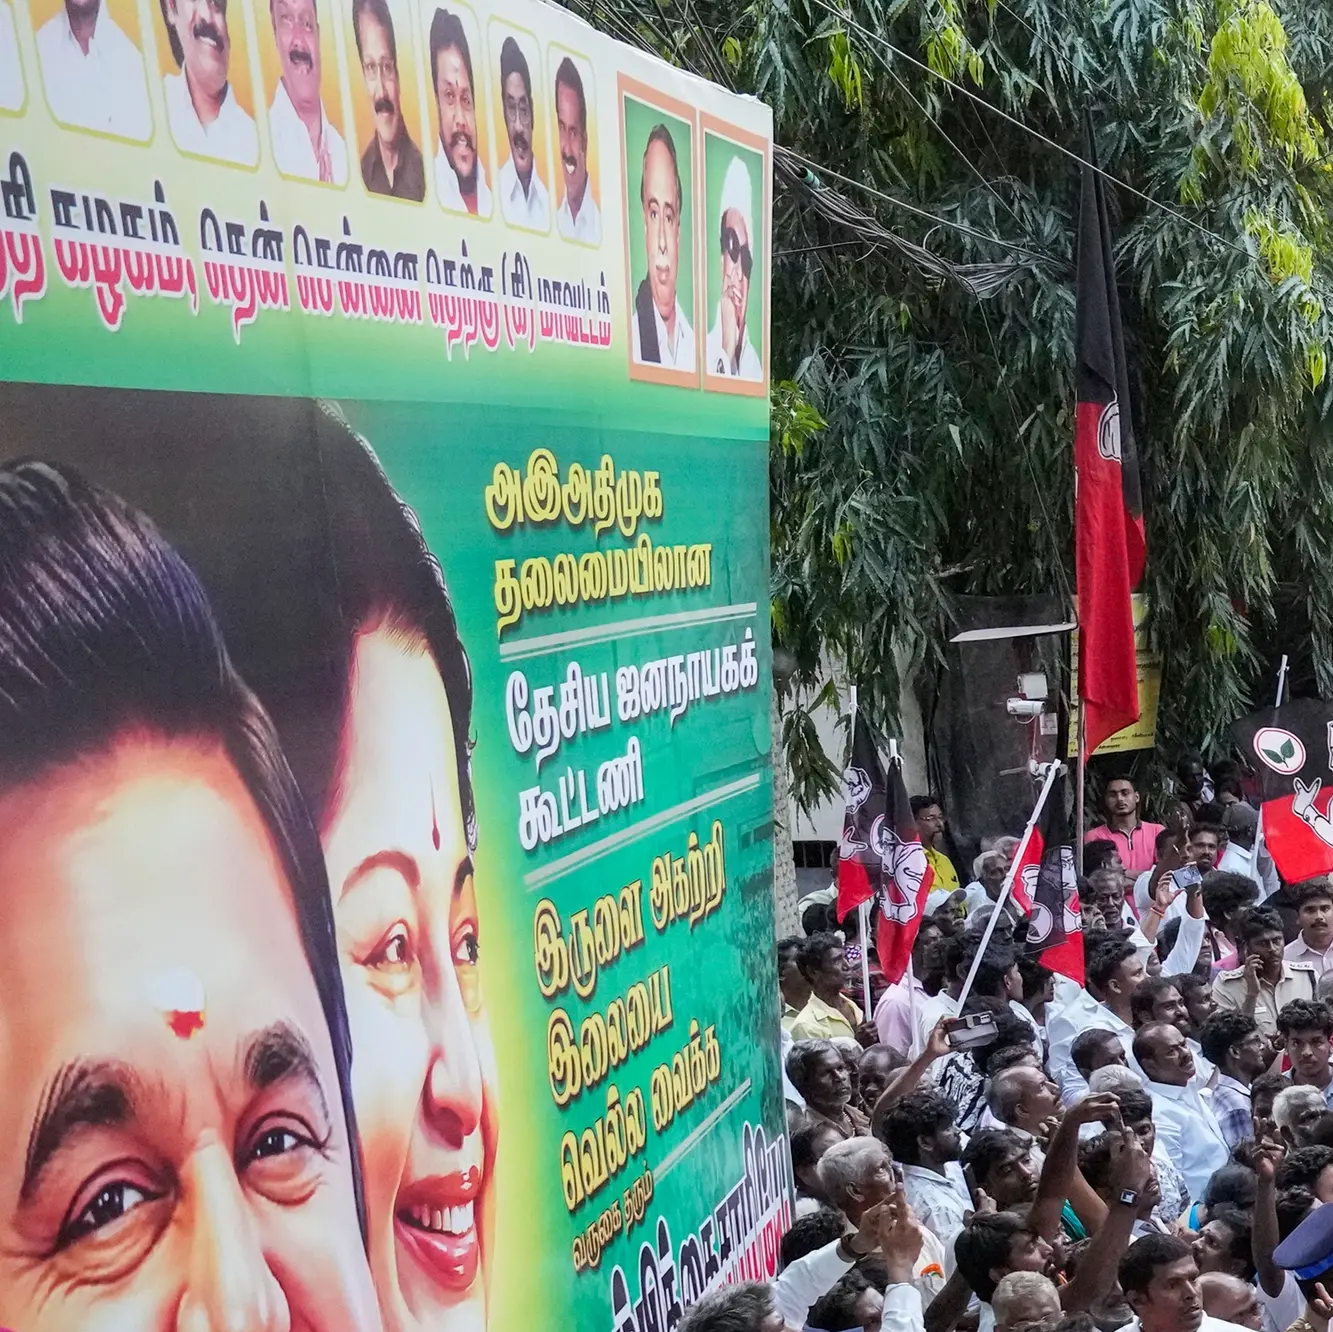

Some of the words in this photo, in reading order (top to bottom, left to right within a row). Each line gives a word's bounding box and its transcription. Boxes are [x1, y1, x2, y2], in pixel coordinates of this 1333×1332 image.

[50, 179, 198, 328] கழகம்,
[201, 199, 290, 340] தென்
[293, 215, 423, 322] சென்னை
[425, 238, 500, 359] தெற்கு
[537, 270, 613, 348] மாவட்டம்
[484, 447, 664, 537] அஇஅதிமுக
[493, 533, 712, 632] தலைமையிலான
[505, 661, 612, 773] தேசிய
[616, 627, 760, 732] ஜனநாயகக்
[518, 736, 645, 852] கூட்டணி
[533, 878, 646, 998] இருளை
[649, 820, 728, 930] அகற்றி
[547, 965, 675, 1106] இலையை
[559, 1080, 647, 1212] வெல்ல
[651, 1018, 722, 1133] வைக்க
[572, 1197, 622, 1273] வருகை
[623, 1160, 655, 1236] தரும்
